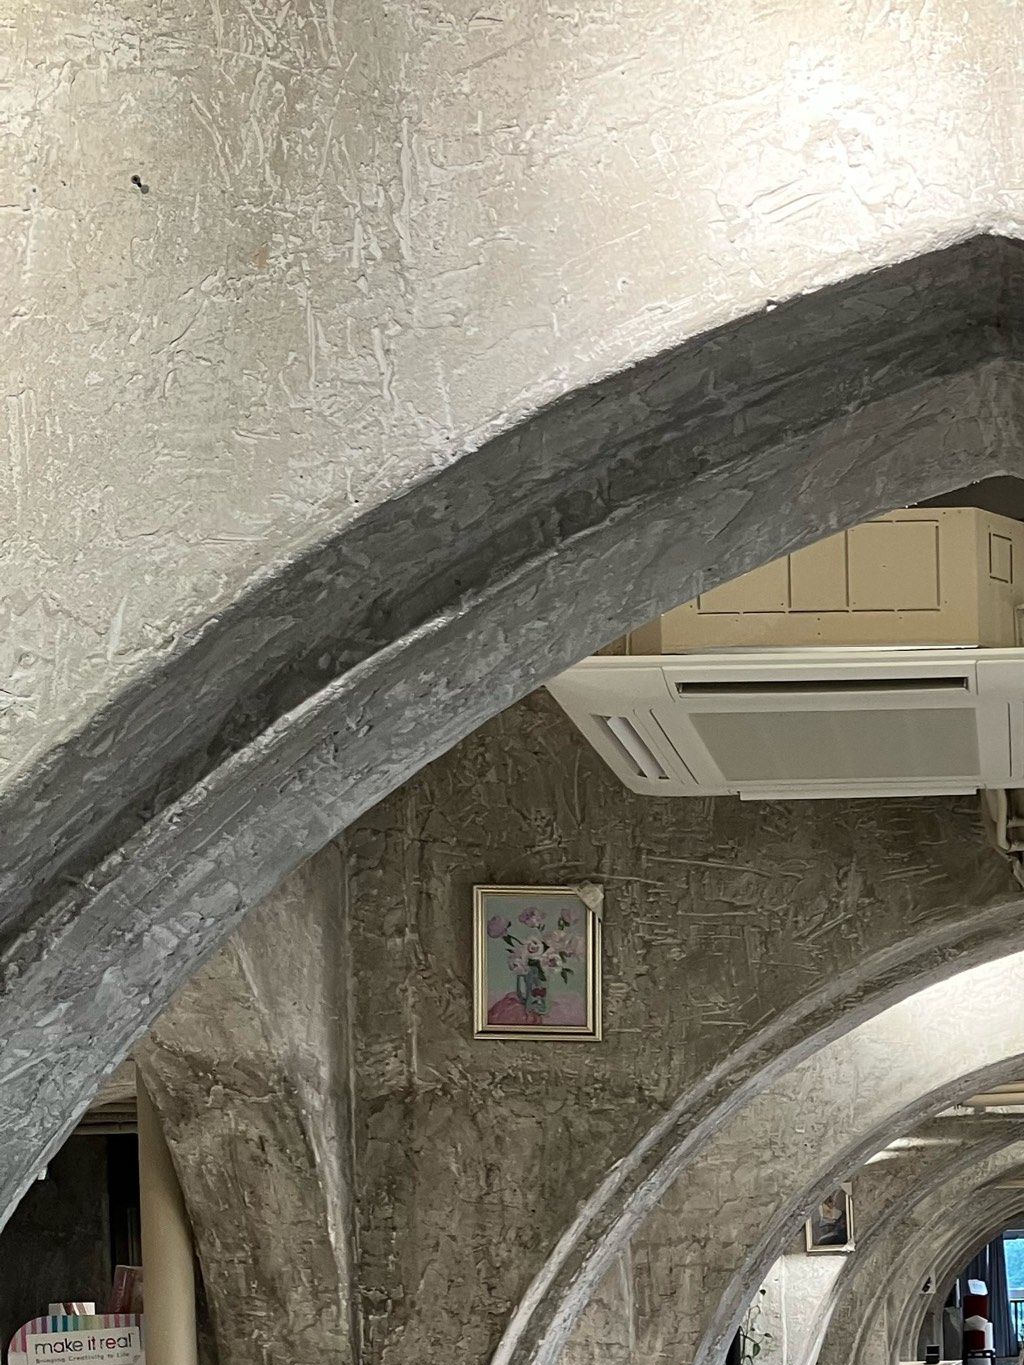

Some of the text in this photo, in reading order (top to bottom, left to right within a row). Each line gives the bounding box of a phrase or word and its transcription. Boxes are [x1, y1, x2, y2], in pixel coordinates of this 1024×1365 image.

[35, 1333, 133, 1355] make it real
